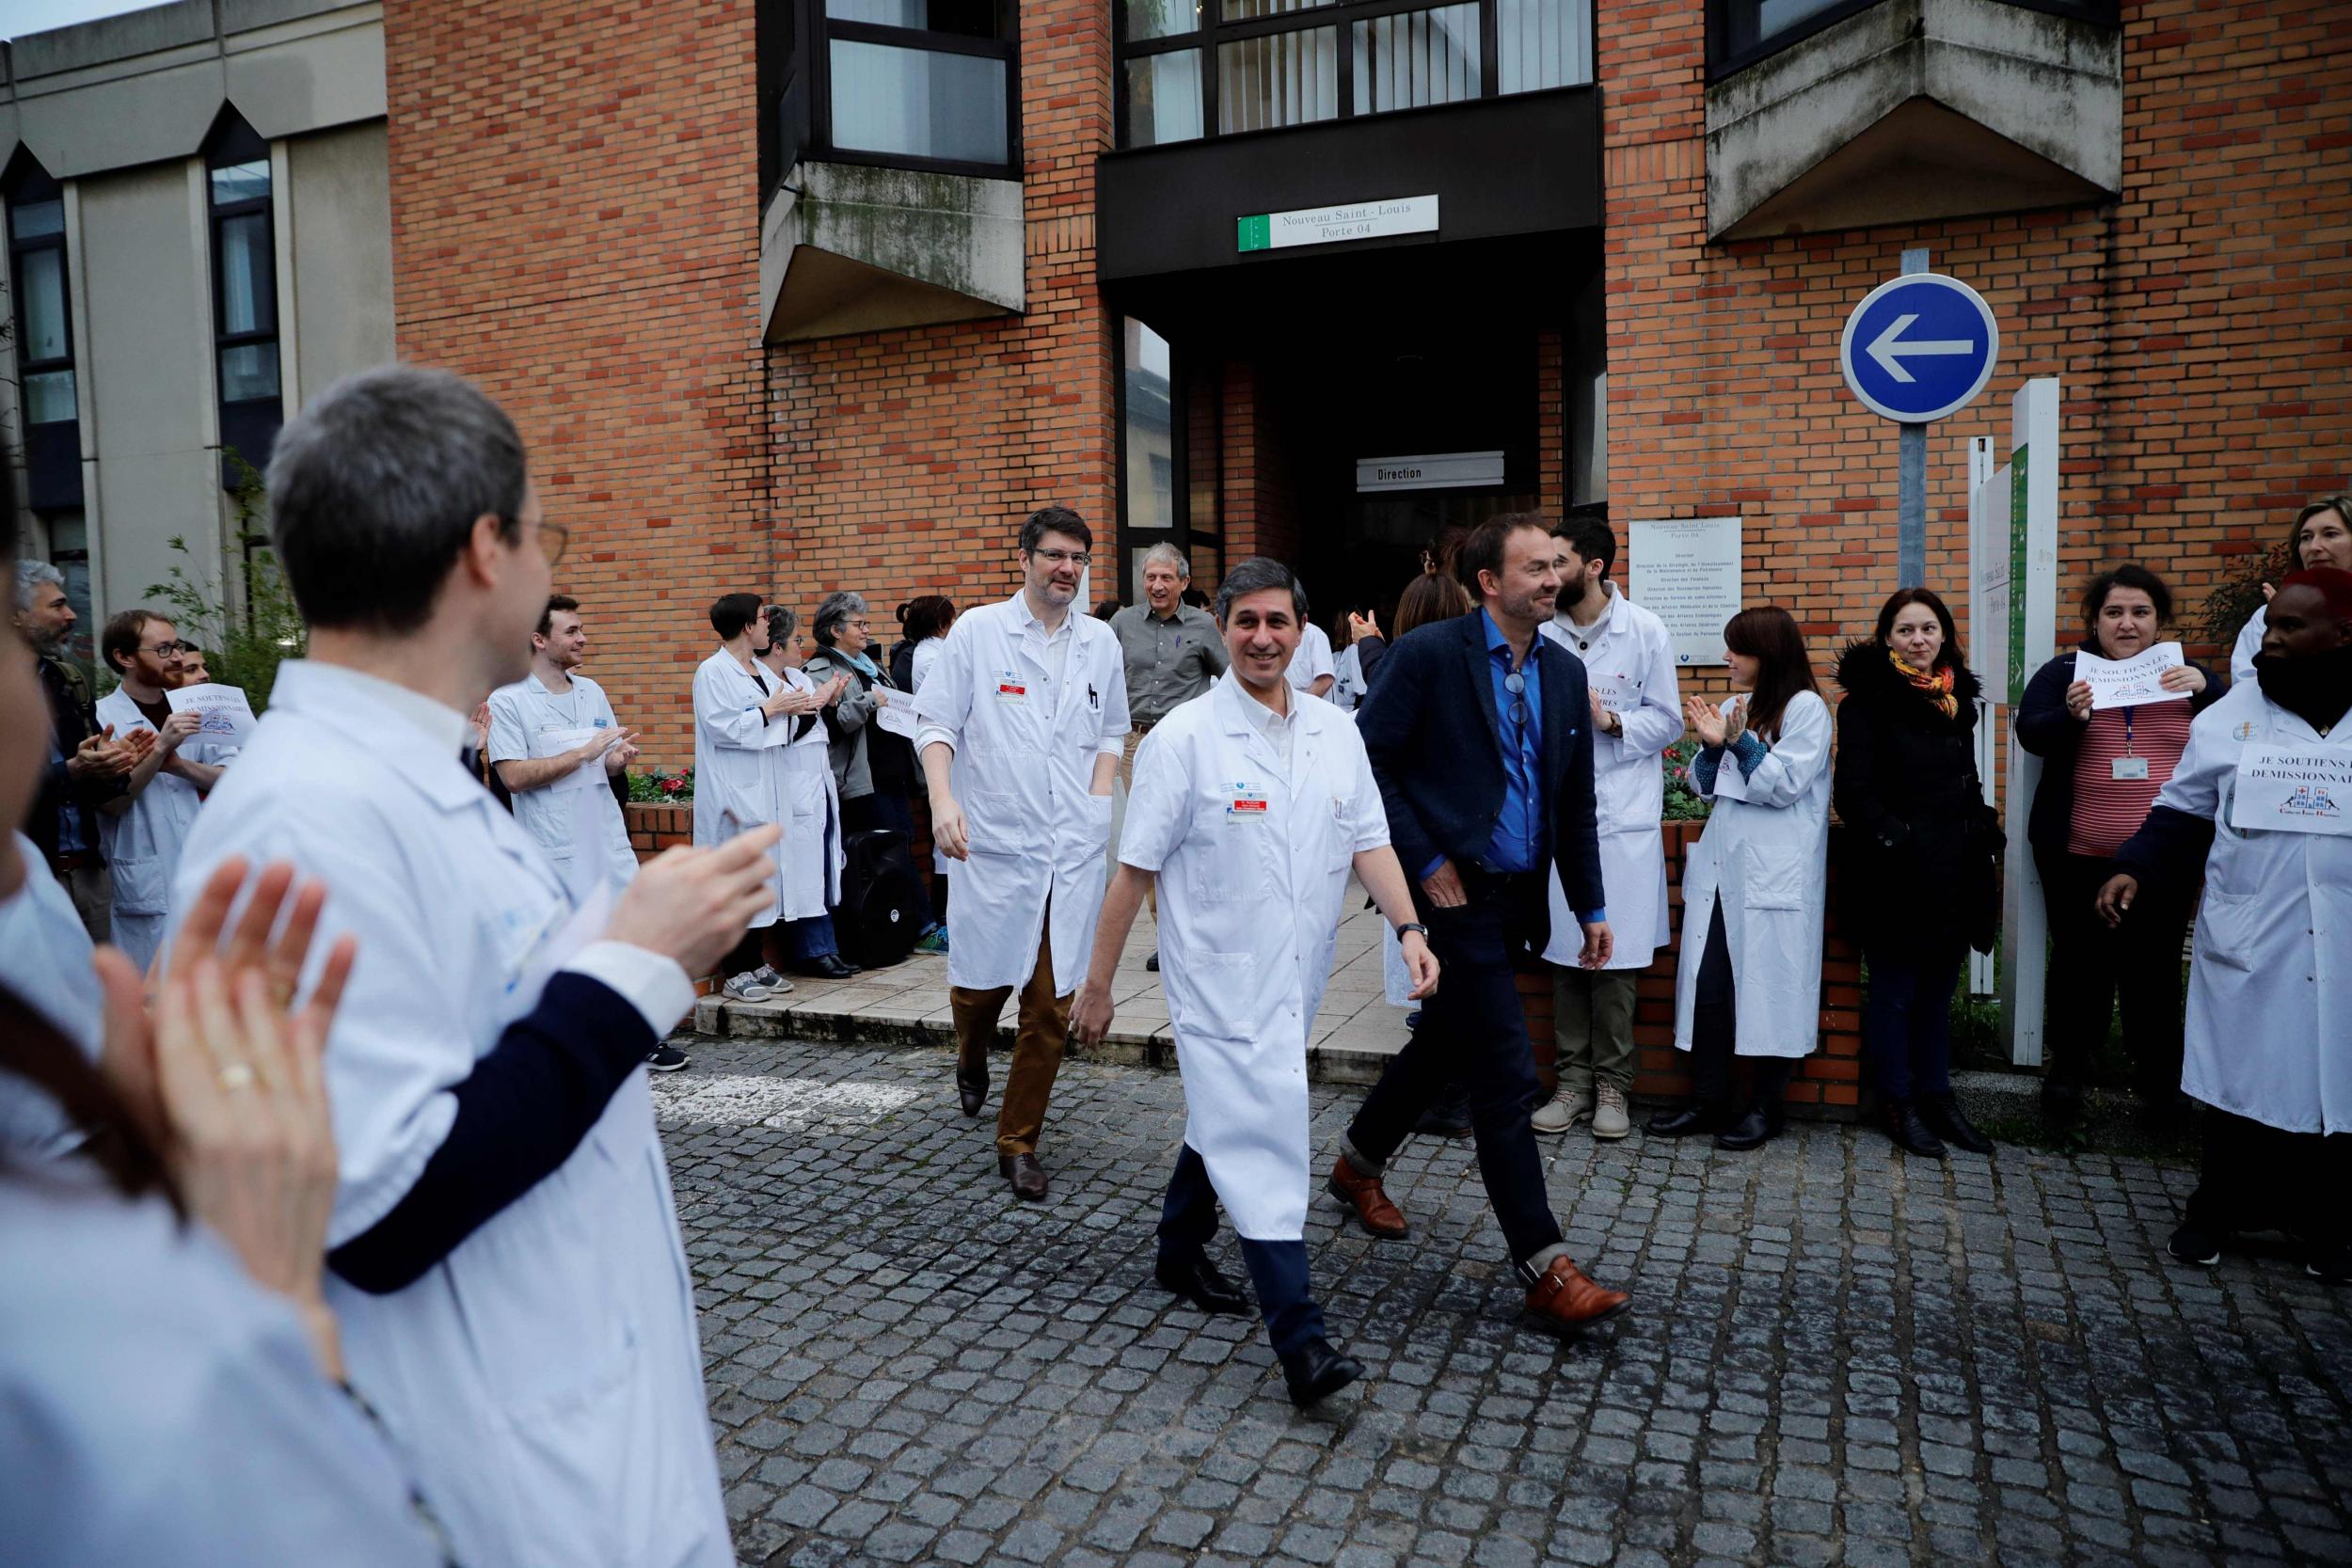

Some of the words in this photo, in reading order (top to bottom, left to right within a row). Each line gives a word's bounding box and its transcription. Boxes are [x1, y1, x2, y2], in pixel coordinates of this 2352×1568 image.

[1283, 213, 1330, 227] Nouveau
[1335, 209, 1366, 220] Saint
[1378, 204, 1411, 215] Louis
[1322, 225, 1353, 238] Porte
[1358, 224, 1371, 234] 04
[1377, 468, 1422, 481] Direction
[2090, 666, 2098, 674] JE
[2102, 662, 2151, 675] SOUTIENS
[2152, 654, 2170, 665] LES
[2259, 756, 2274, 765] JE
[2277, 756, 2346, 768] SOUTIENS
